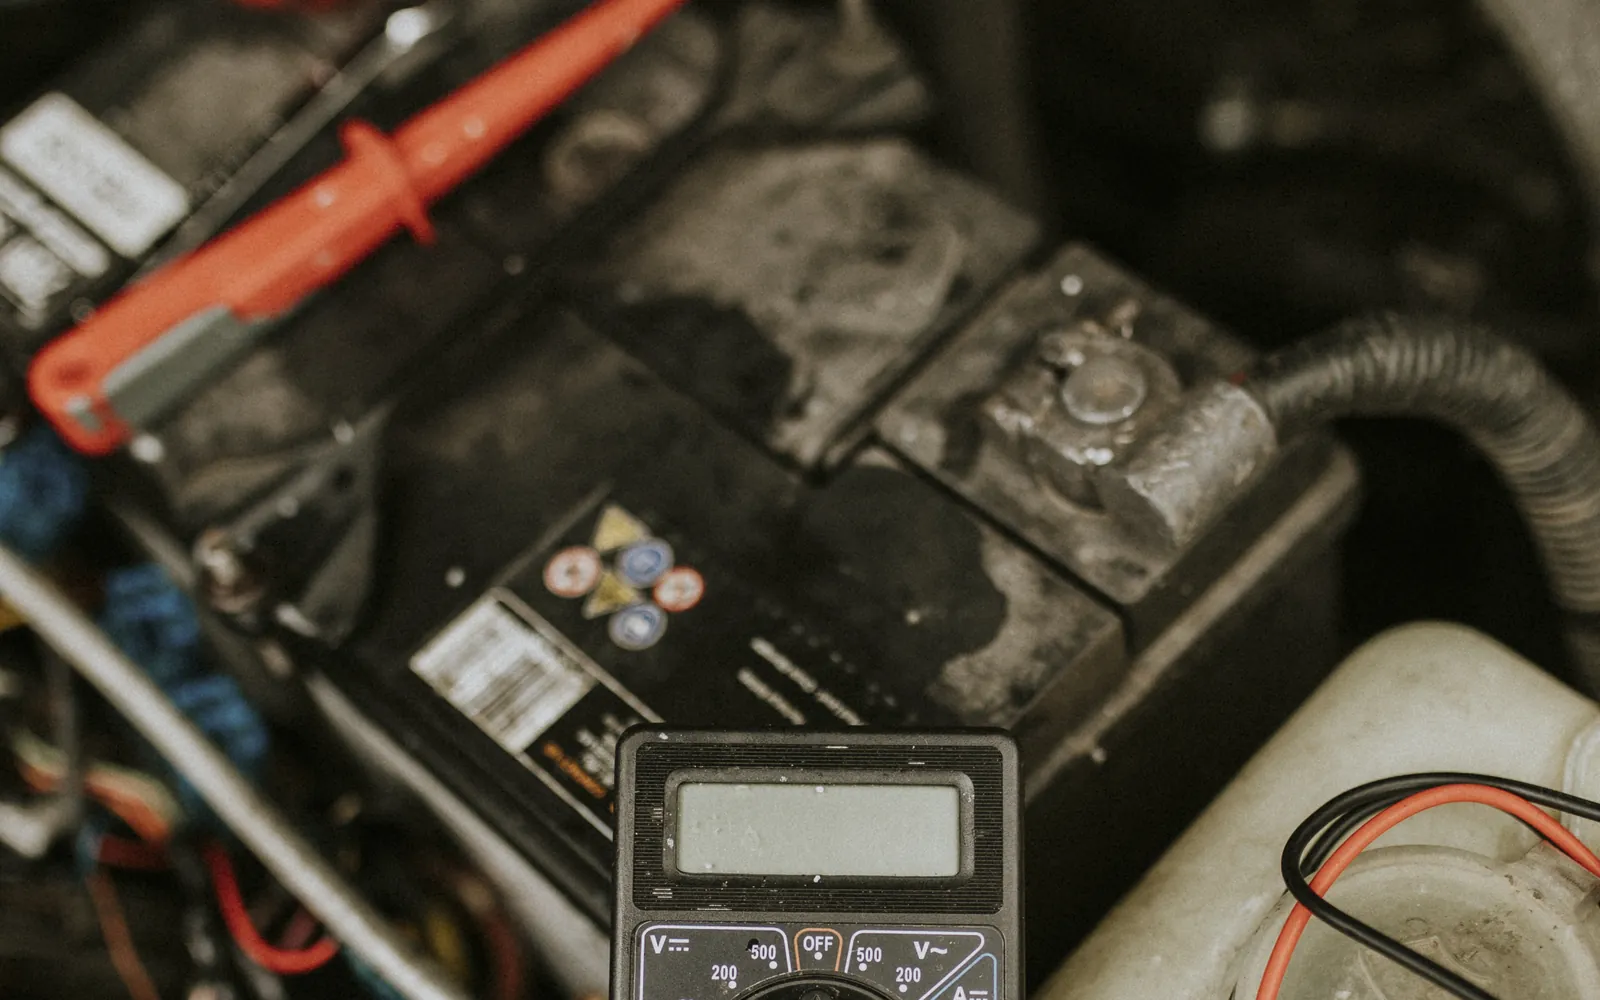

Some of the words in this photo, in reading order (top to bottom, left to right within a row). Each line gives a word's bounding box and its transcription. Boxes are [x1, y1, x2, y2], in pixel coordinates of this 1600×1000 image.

[803, 935, 834, 951] OFF
[751, 944, 776, 960] 500
[856, 947, 882, 962] 500
[711, 965, 737, 980] 200
[895, 967, 921, 983] 200
